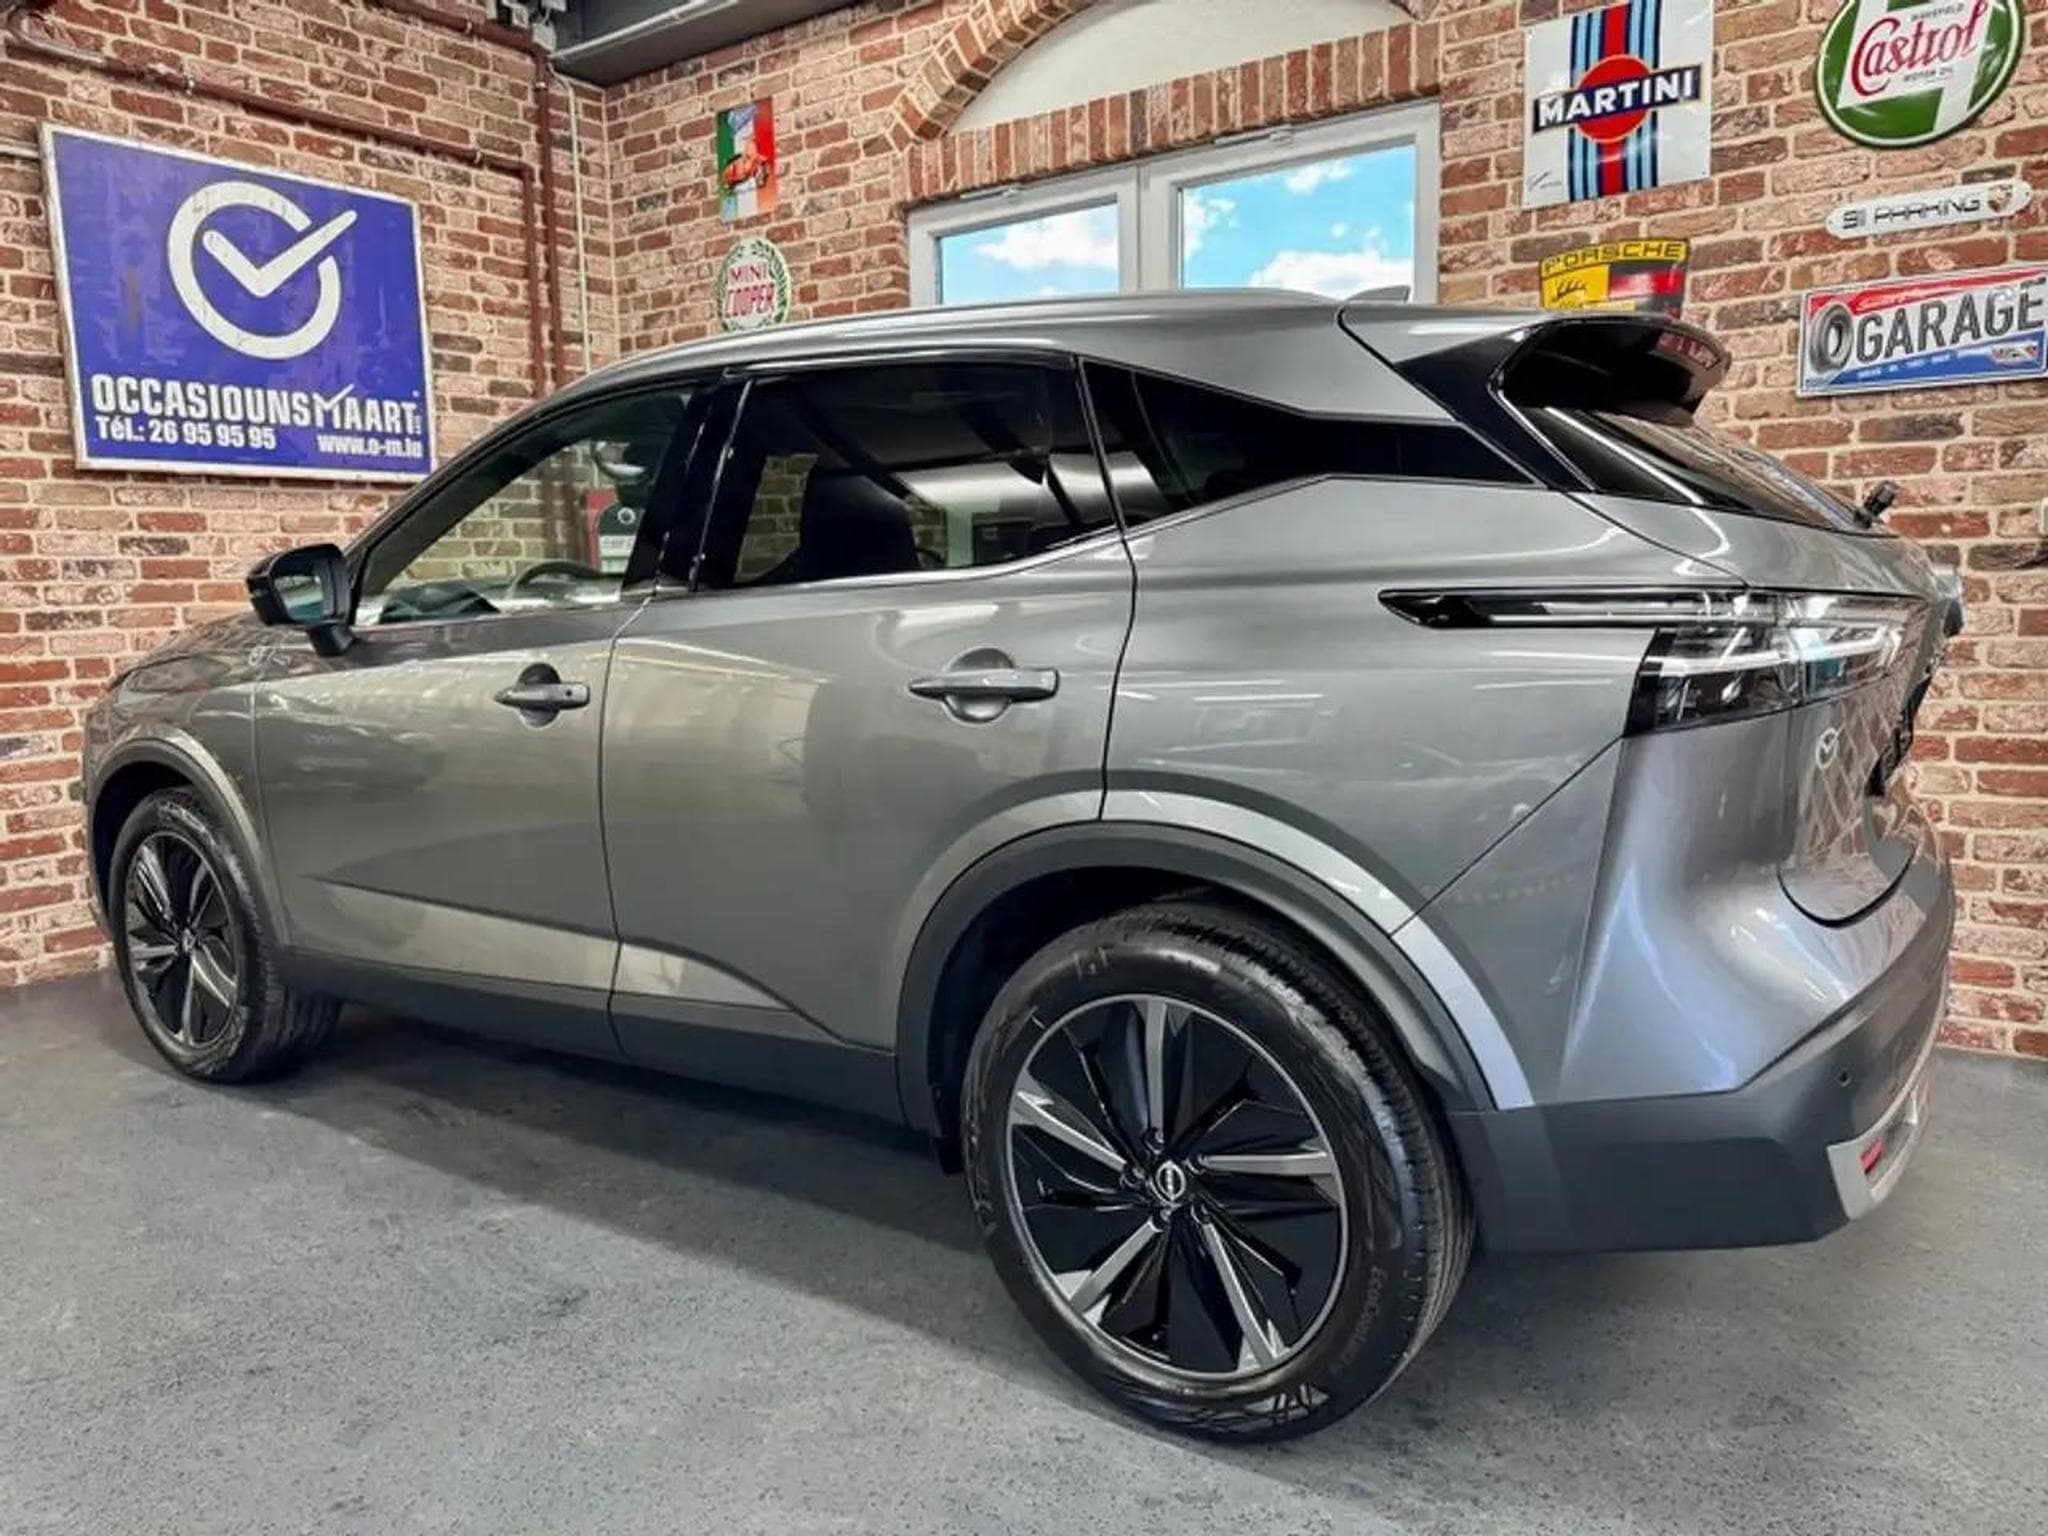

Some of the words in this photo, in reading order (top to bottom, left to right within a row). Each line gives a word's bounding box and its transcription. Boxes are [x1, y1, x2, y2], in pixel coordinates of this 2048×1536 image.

[1851, 0, 1989, 97] Castrol
[1537, 70, 1694, 128] MARTINI
[1874, 193, 1981, 224] PARKING
[1544, 242, 1682, 273] PORSCHE
[1855, 276, 2047, 364] GARAGE
[91, 373, 418, 435] OCCASIOUNSMAART
[148, 418, 179, 444] 26
[182, 420, 212, 446] 95
[215, 422, 245, 448] 95
[247, 425, 277, 450] 95
